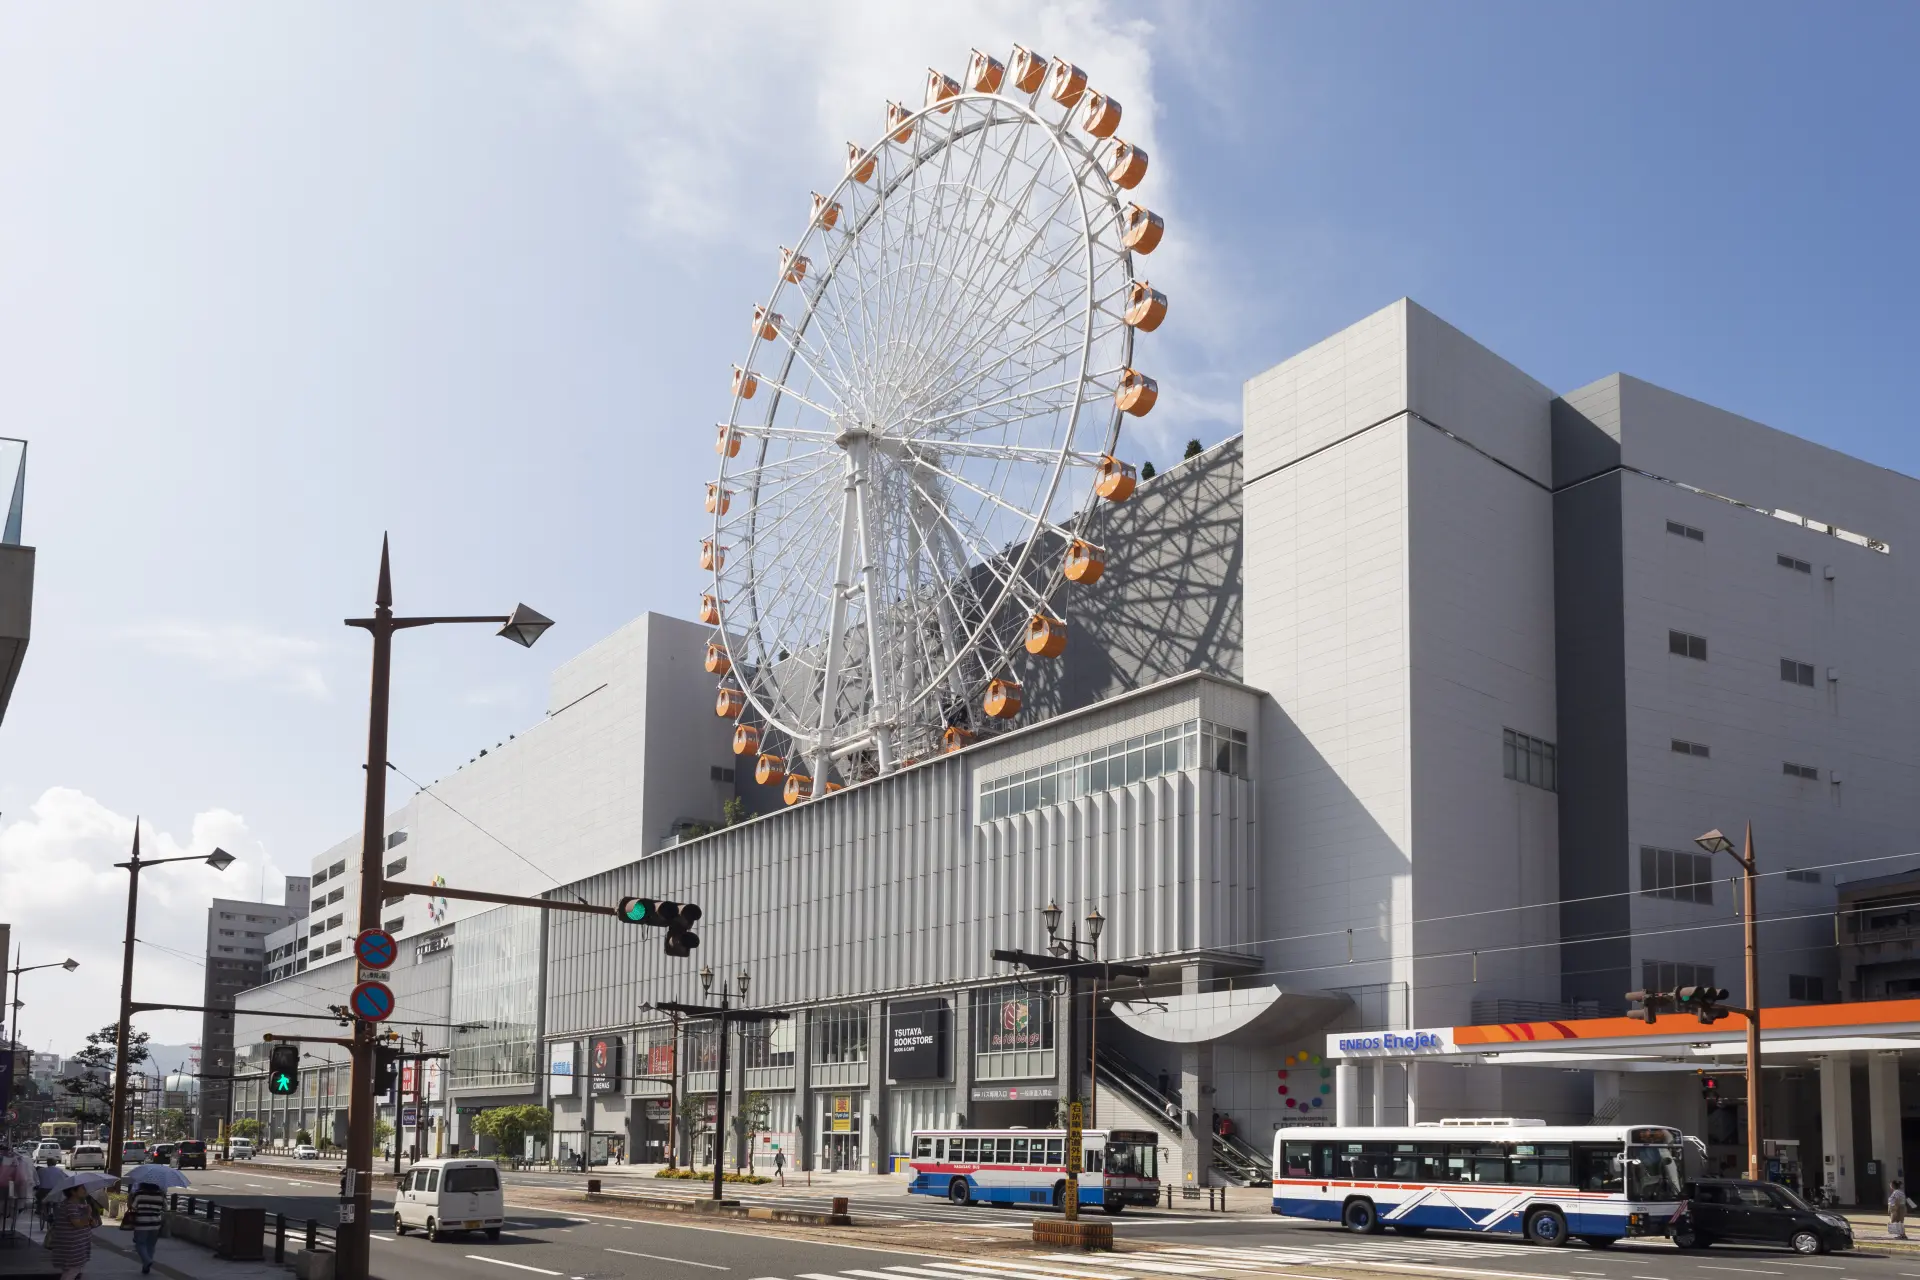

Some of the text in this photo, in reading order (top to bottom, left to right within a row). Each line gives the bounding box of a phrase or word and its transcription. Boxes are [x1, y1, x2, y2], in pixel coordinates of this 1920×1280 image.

[894, 1028, 922, 1037] TSUTAYA
[894, 1036, 933, 1046] BOOKSTORE
[992, 1032, 1040, 1046] Red Cabbage
[1340, 1032, 1437, 1051] ENEOS Enejet
[552, 1061, 573, 1075] SEGA
[593, 1082, 610, 1090] CINEMAS
